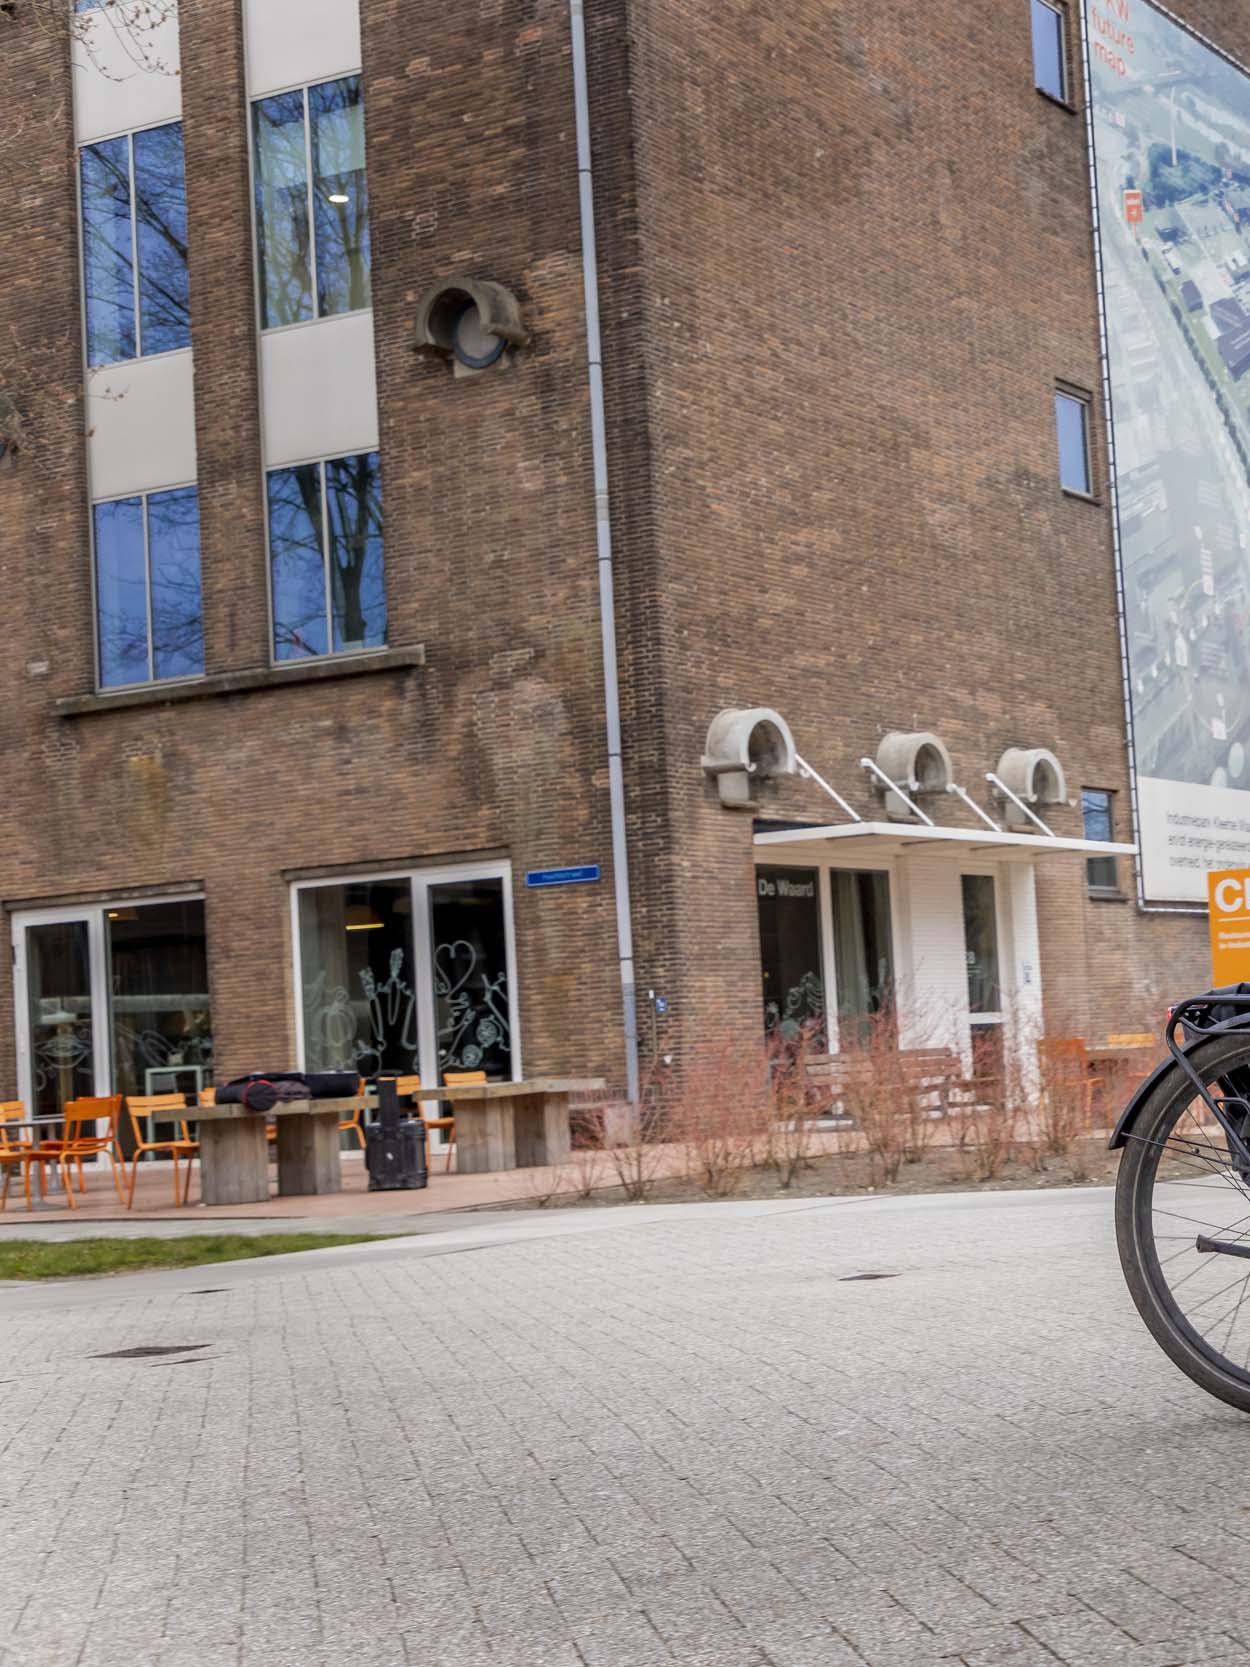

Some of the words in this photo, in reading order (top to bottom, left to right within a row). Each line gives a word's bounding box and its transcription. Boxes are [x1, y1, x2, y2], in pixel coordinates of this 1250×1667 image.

[1091, 6, 1136, 54] future
[1093, 41, 1126, 76] map
[758, 878, 776, 896] De
[776, 879, 815, 897] Waard
